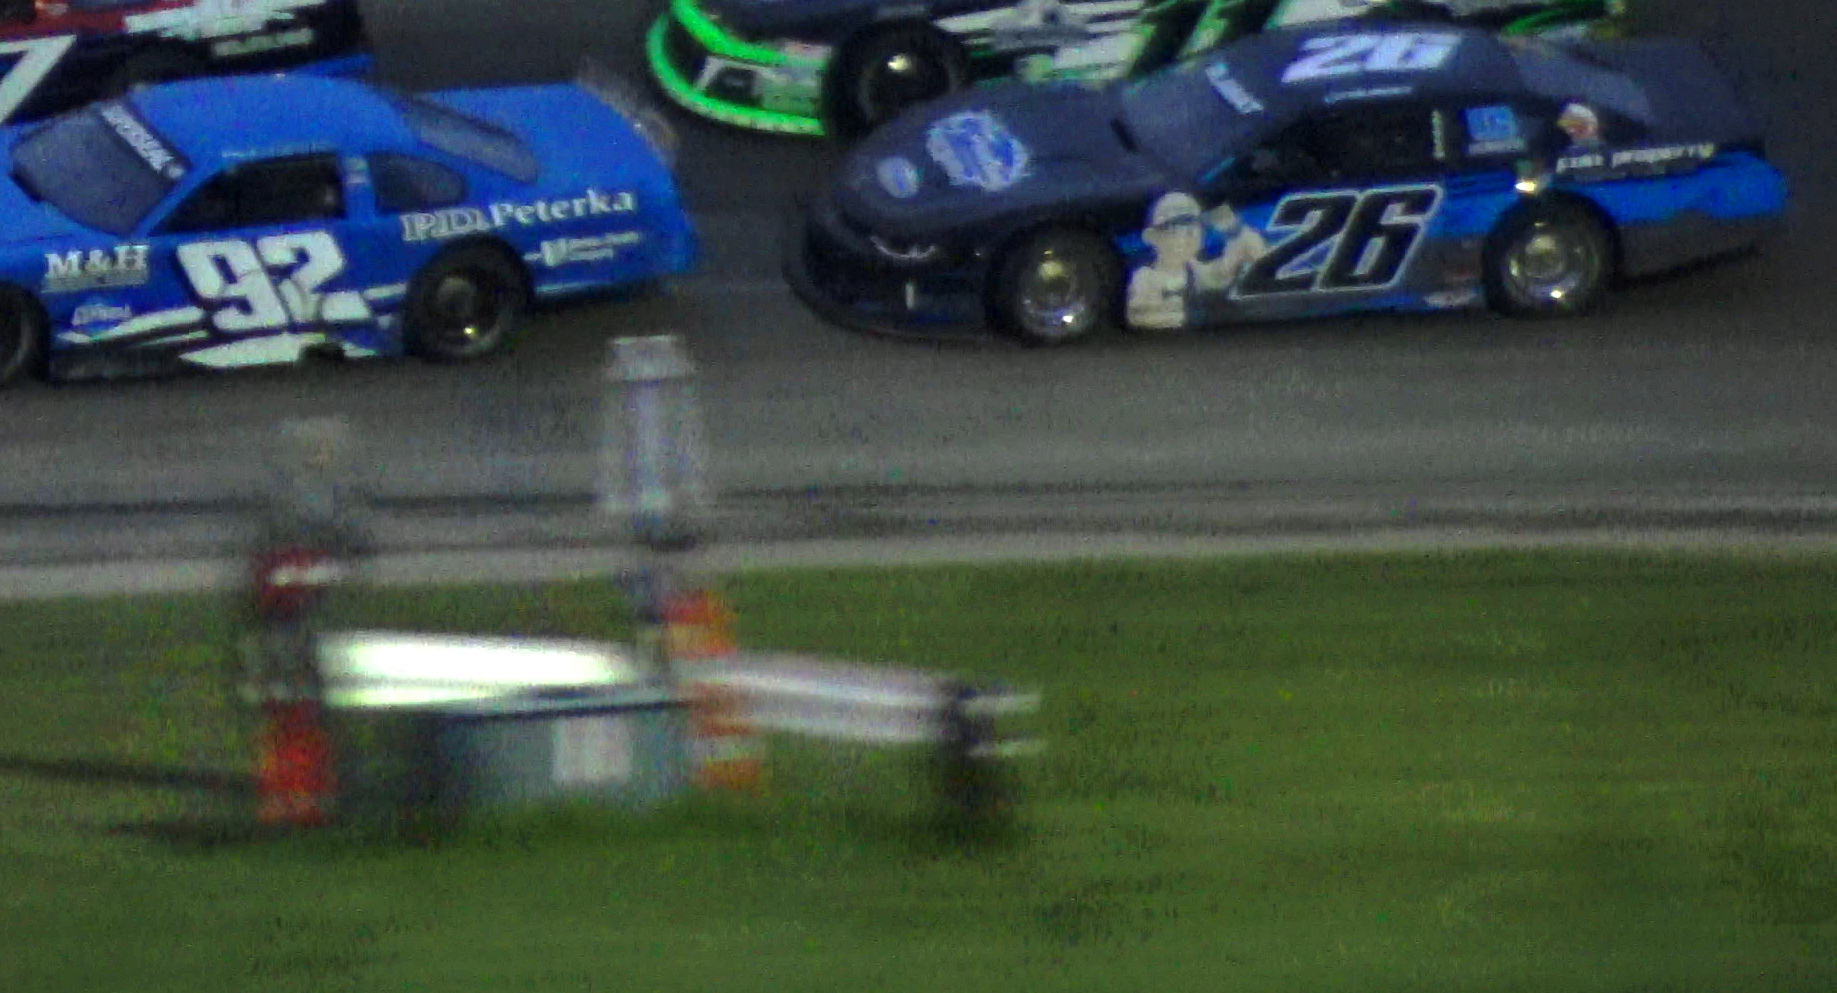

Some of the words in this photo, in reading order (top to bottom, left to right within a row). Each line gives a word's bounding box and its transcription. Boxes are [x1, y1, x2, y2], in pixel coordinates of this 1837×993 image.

[1282, 32, 1460, 84] 26
[489, 188, 634, 228] Peterka
[44, 244, 150, 278] M&H
[1232, 183, 1444, 301] 26
[176, 232, 370, 330] 92
